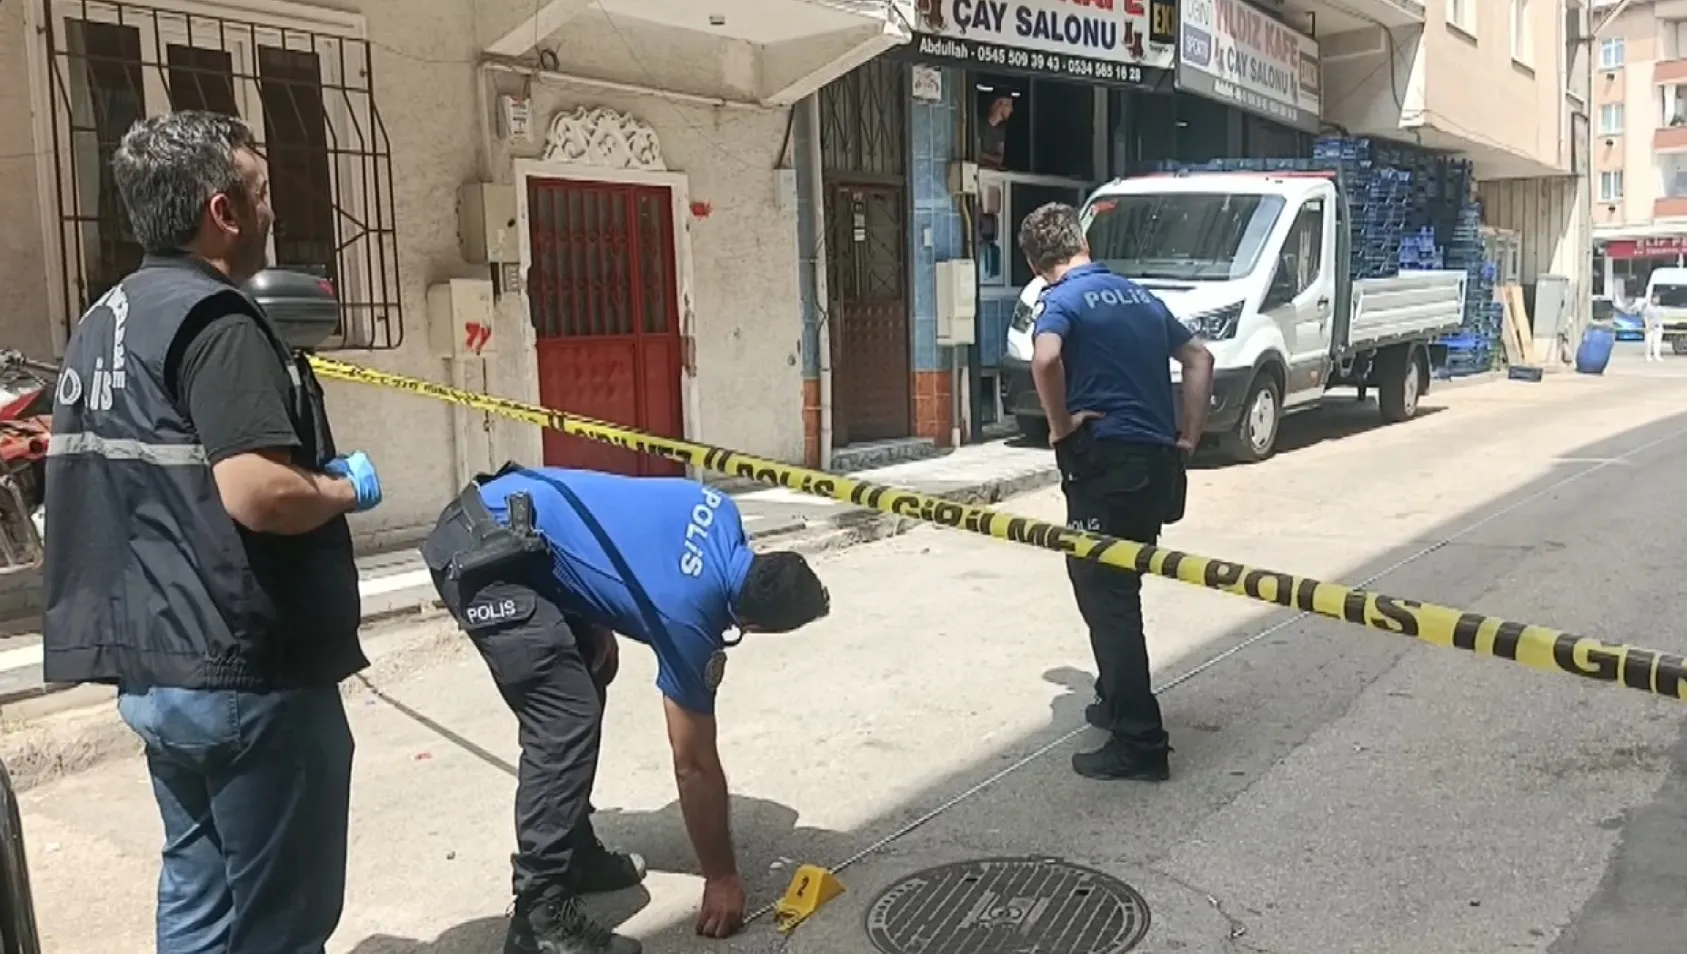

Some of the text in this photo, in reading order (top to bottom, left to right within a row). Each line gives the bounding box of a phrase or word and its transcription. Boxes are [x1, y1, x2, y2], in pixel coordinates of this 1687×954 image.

[919, 37, 968, 59] Abdullah
[952, 0, 1008, 34] ÇAY
[1015, 5, 1116, 50] SALONU
[1265, 20, 1298, 68] KAFE
[1250, 56, 1288, 95] SALONU
[681, 487, 722, 577] POLİS
